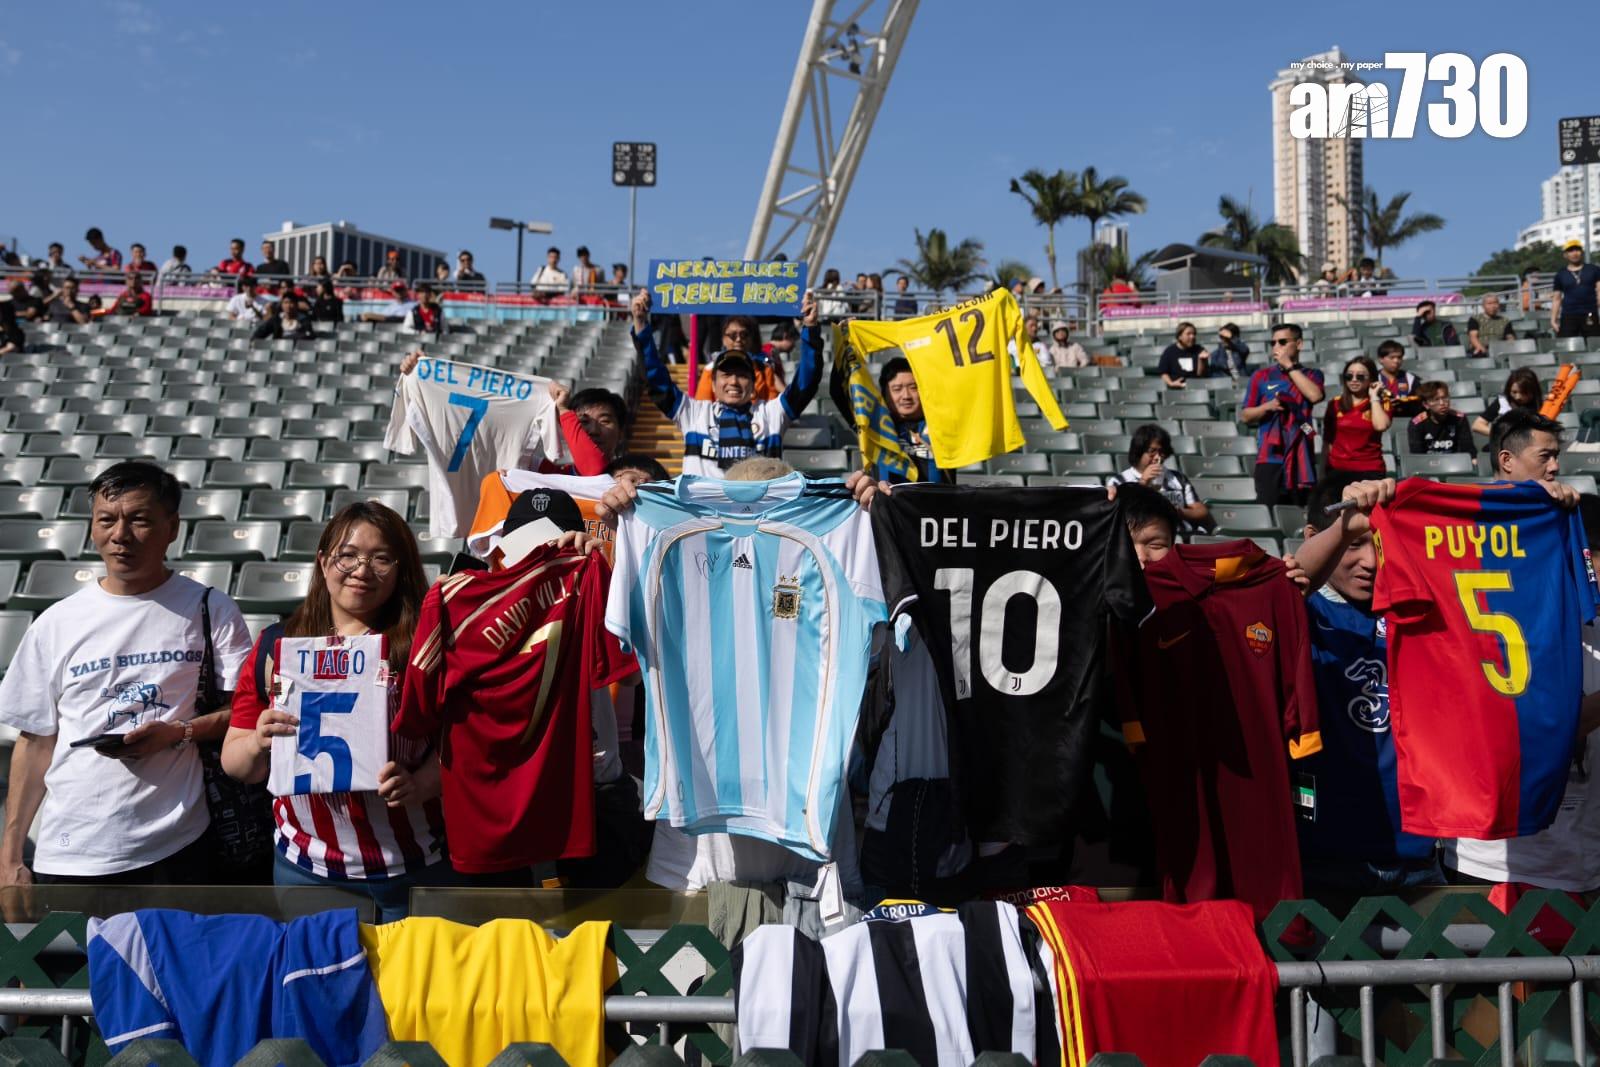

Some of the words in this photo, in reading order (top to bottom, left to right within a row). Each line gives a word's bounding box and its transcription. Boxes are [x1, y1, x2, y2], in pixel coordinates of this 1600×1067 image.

[654, 282, 737, 308] TREBLE
[934, 308, 995, 367] 12
[418, 359, 458, 385] DEL
[467, 366, 533, 401] PIERO
[447, 391, 490, 473] 7
[920, 517, 977, 548] DEL
[989, 518, 1084, 551] PIERO
[1424, 524, 1527, 560] PUYOL
[481, 597, 531, 651] DAVID
[933, 567, 1062, 701] 10
[1452, 569, 1533, 698] 5
[69, 656, 112, 678] YALE
[116, 650, 203, 668] BULLDOGS
[297, 649, 366, 675] TIAGO
[293, 691, 360, 796] 5
[881, 904, 926, 920] GROUP
